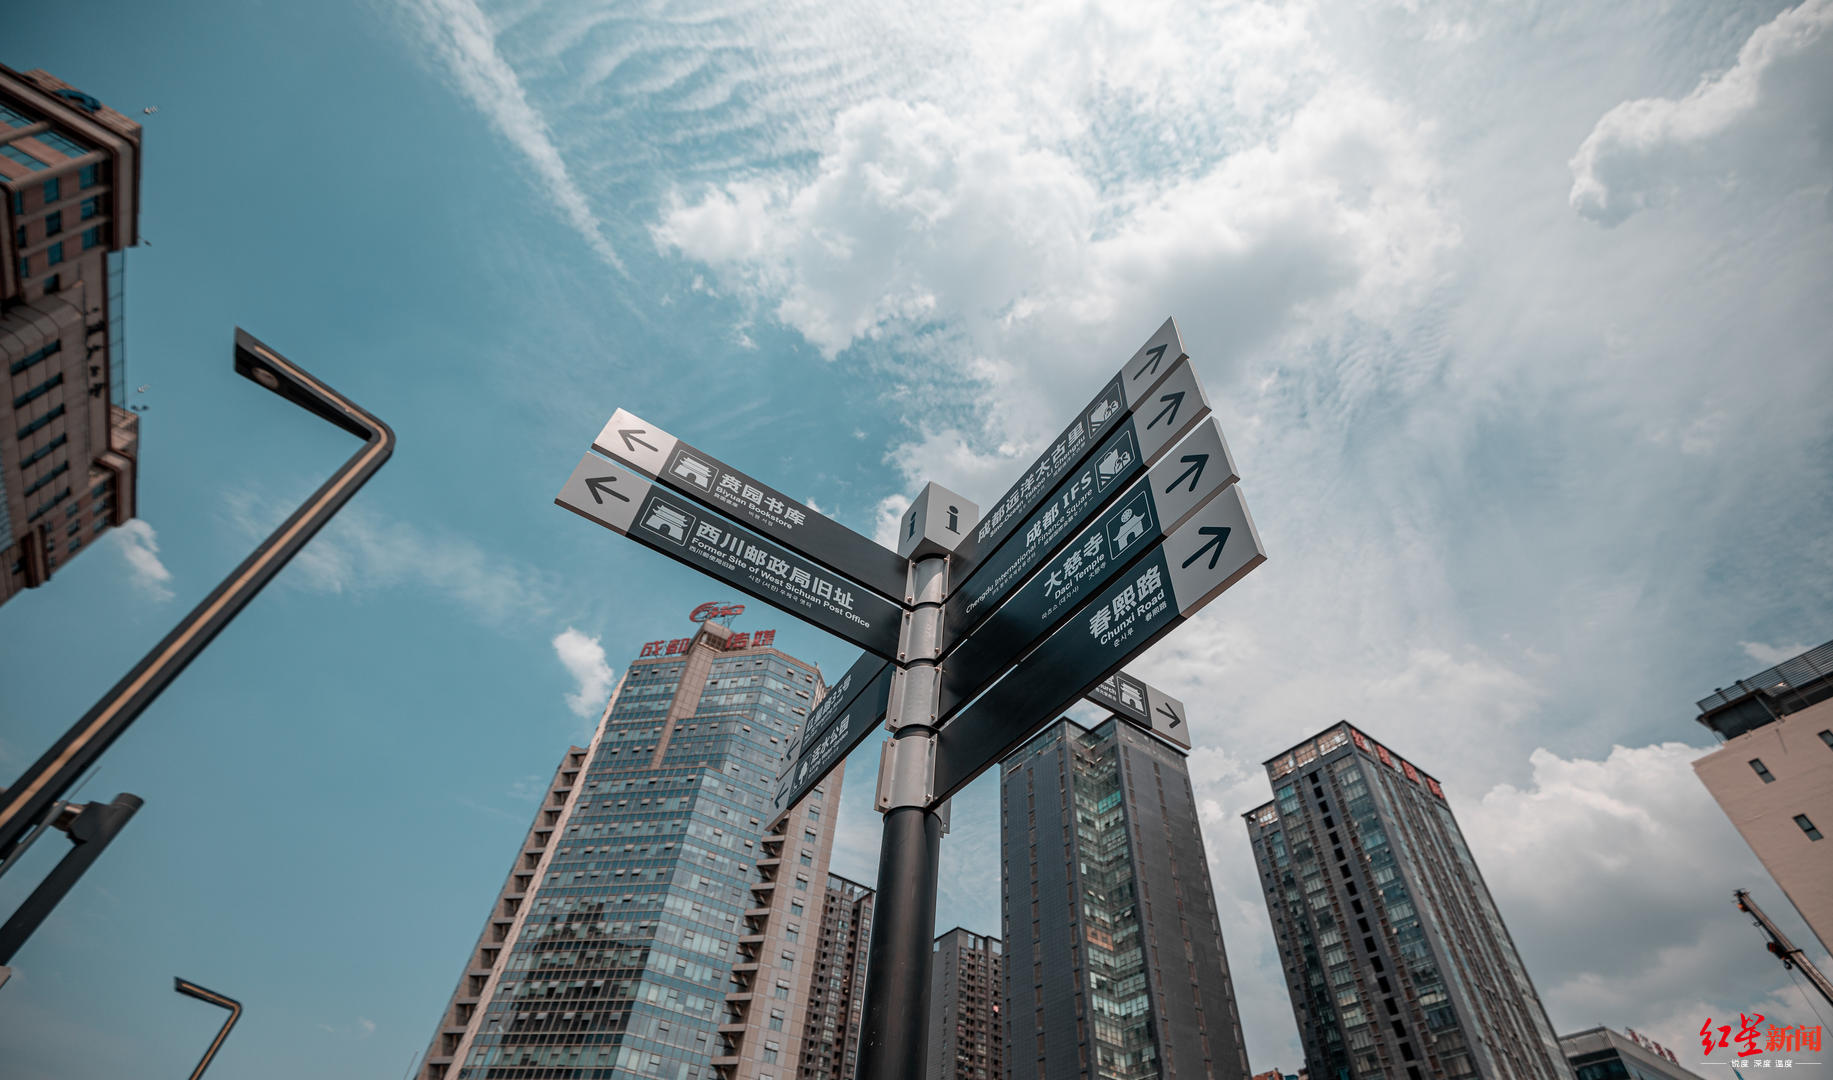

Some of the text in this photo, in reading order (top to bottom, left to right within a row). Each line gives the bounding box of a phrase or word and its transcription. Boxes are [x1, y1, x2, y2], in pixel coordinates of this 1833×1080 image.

[977, 421, 1084, 544] 成都远洋太古里
[1054, 434, 1086, 469] Chengdu
[715, 486, 747, 506] Biyuan
[748, 502, 793, 530] Bookstore
[719, 473, 806, 526] 贲园书库
[1026, 501, 1060, 548] 成都
[1062, 470, 1092, 510] IFS
[692, 537, 870, 629] Former Site of West Sichuan Post Office
[695, 520, 854, 611] 西川邮政局旧址
[966, 584, 994, 614] Chengdu
[994, 541, 1037, 588] International
[1037, 515, 1065, 545] Finance
[1066, 488, 1093, 517] Square
[1044, 532, 1104, 597] 大慈寺
[1054, 553, 1105, 600] Daci Temple
[1089, 564, 1162, 639] 春熙路
[1100, 588, 1165, 645] Chunxi Road
